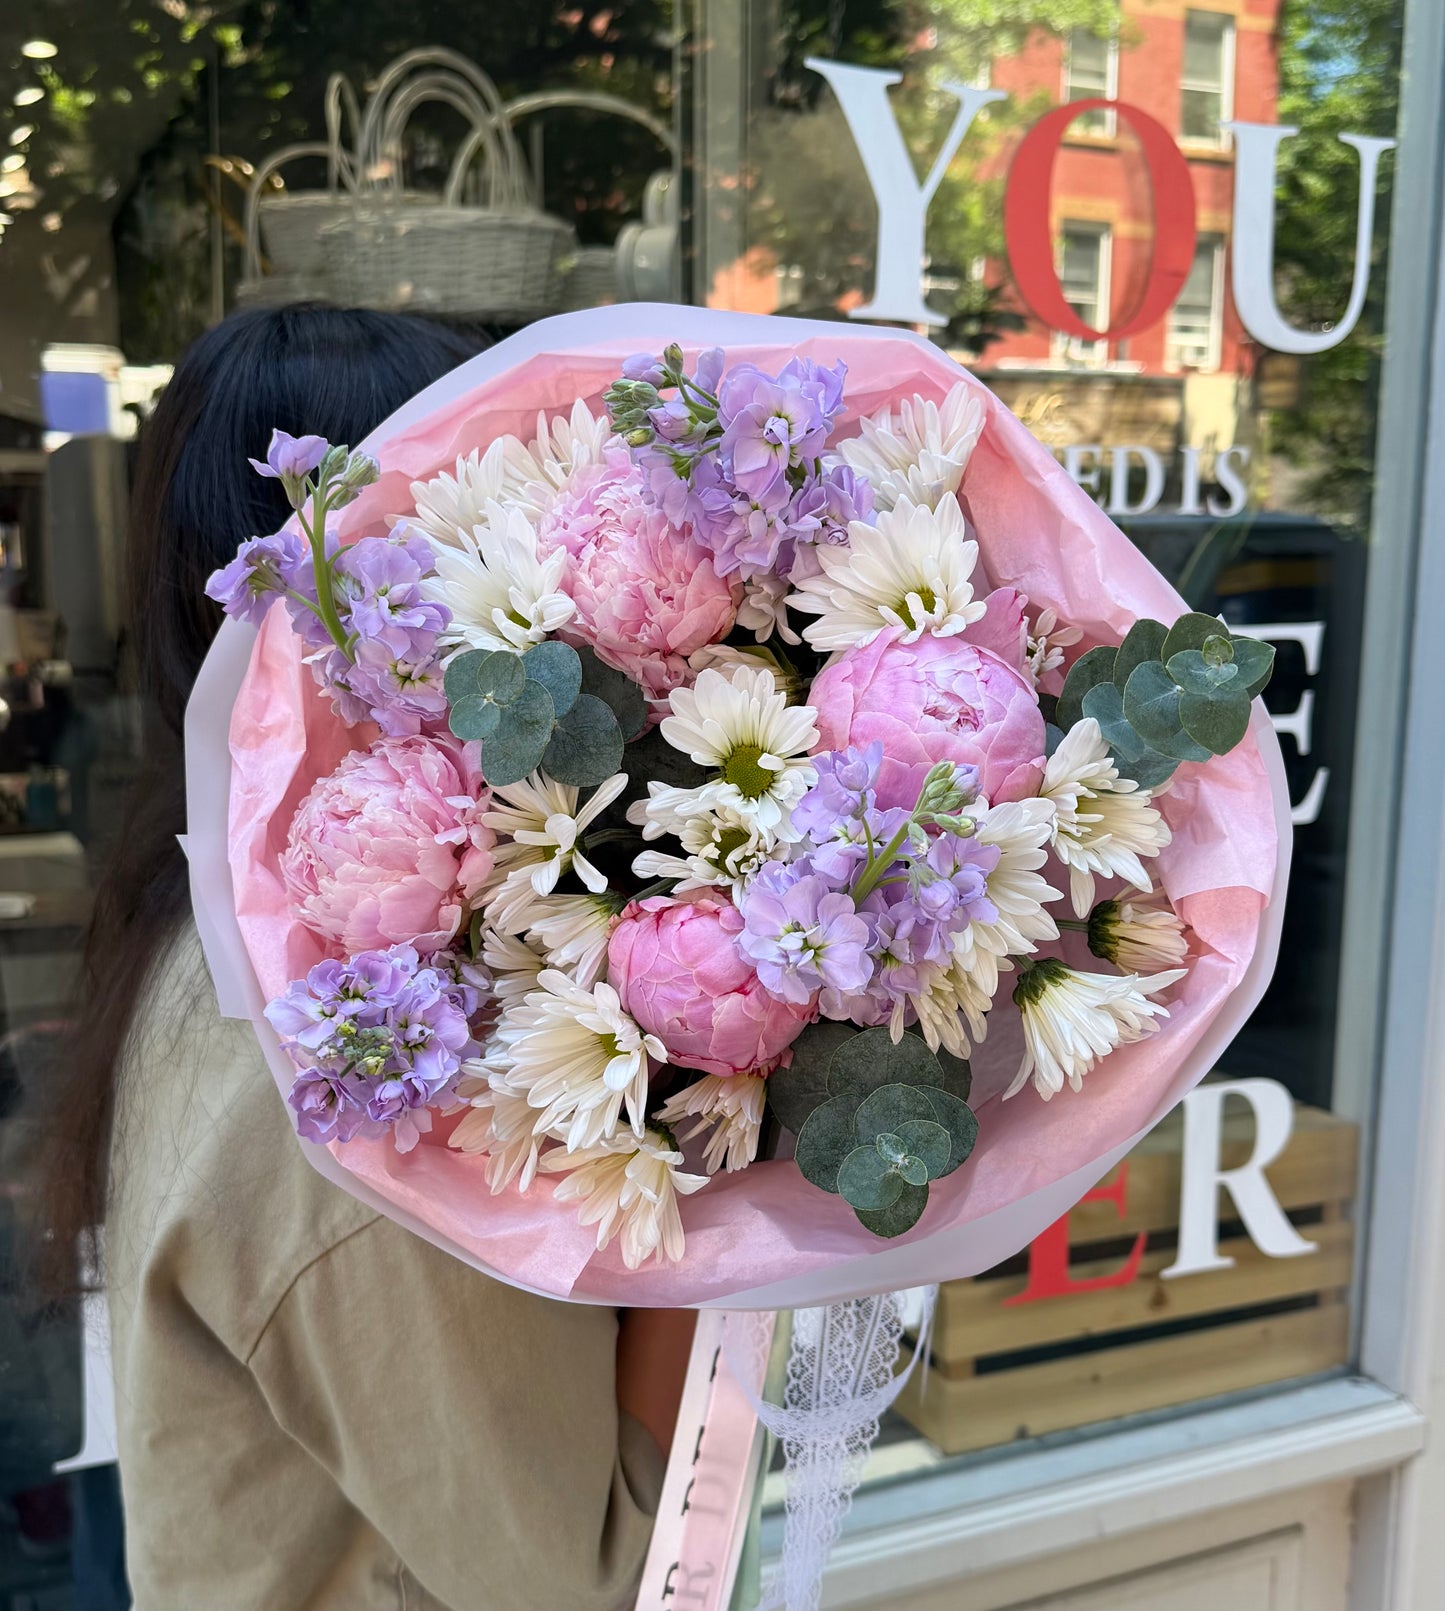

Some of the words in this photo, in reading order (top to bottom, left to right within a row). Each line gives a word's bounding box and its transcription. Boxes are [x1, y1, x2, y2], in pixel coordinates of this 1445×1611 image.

[804, 57, 1396, 355] YOU
[1046, 444, 1166, 516] ED
[1178, 444, 1250, 518] IS
